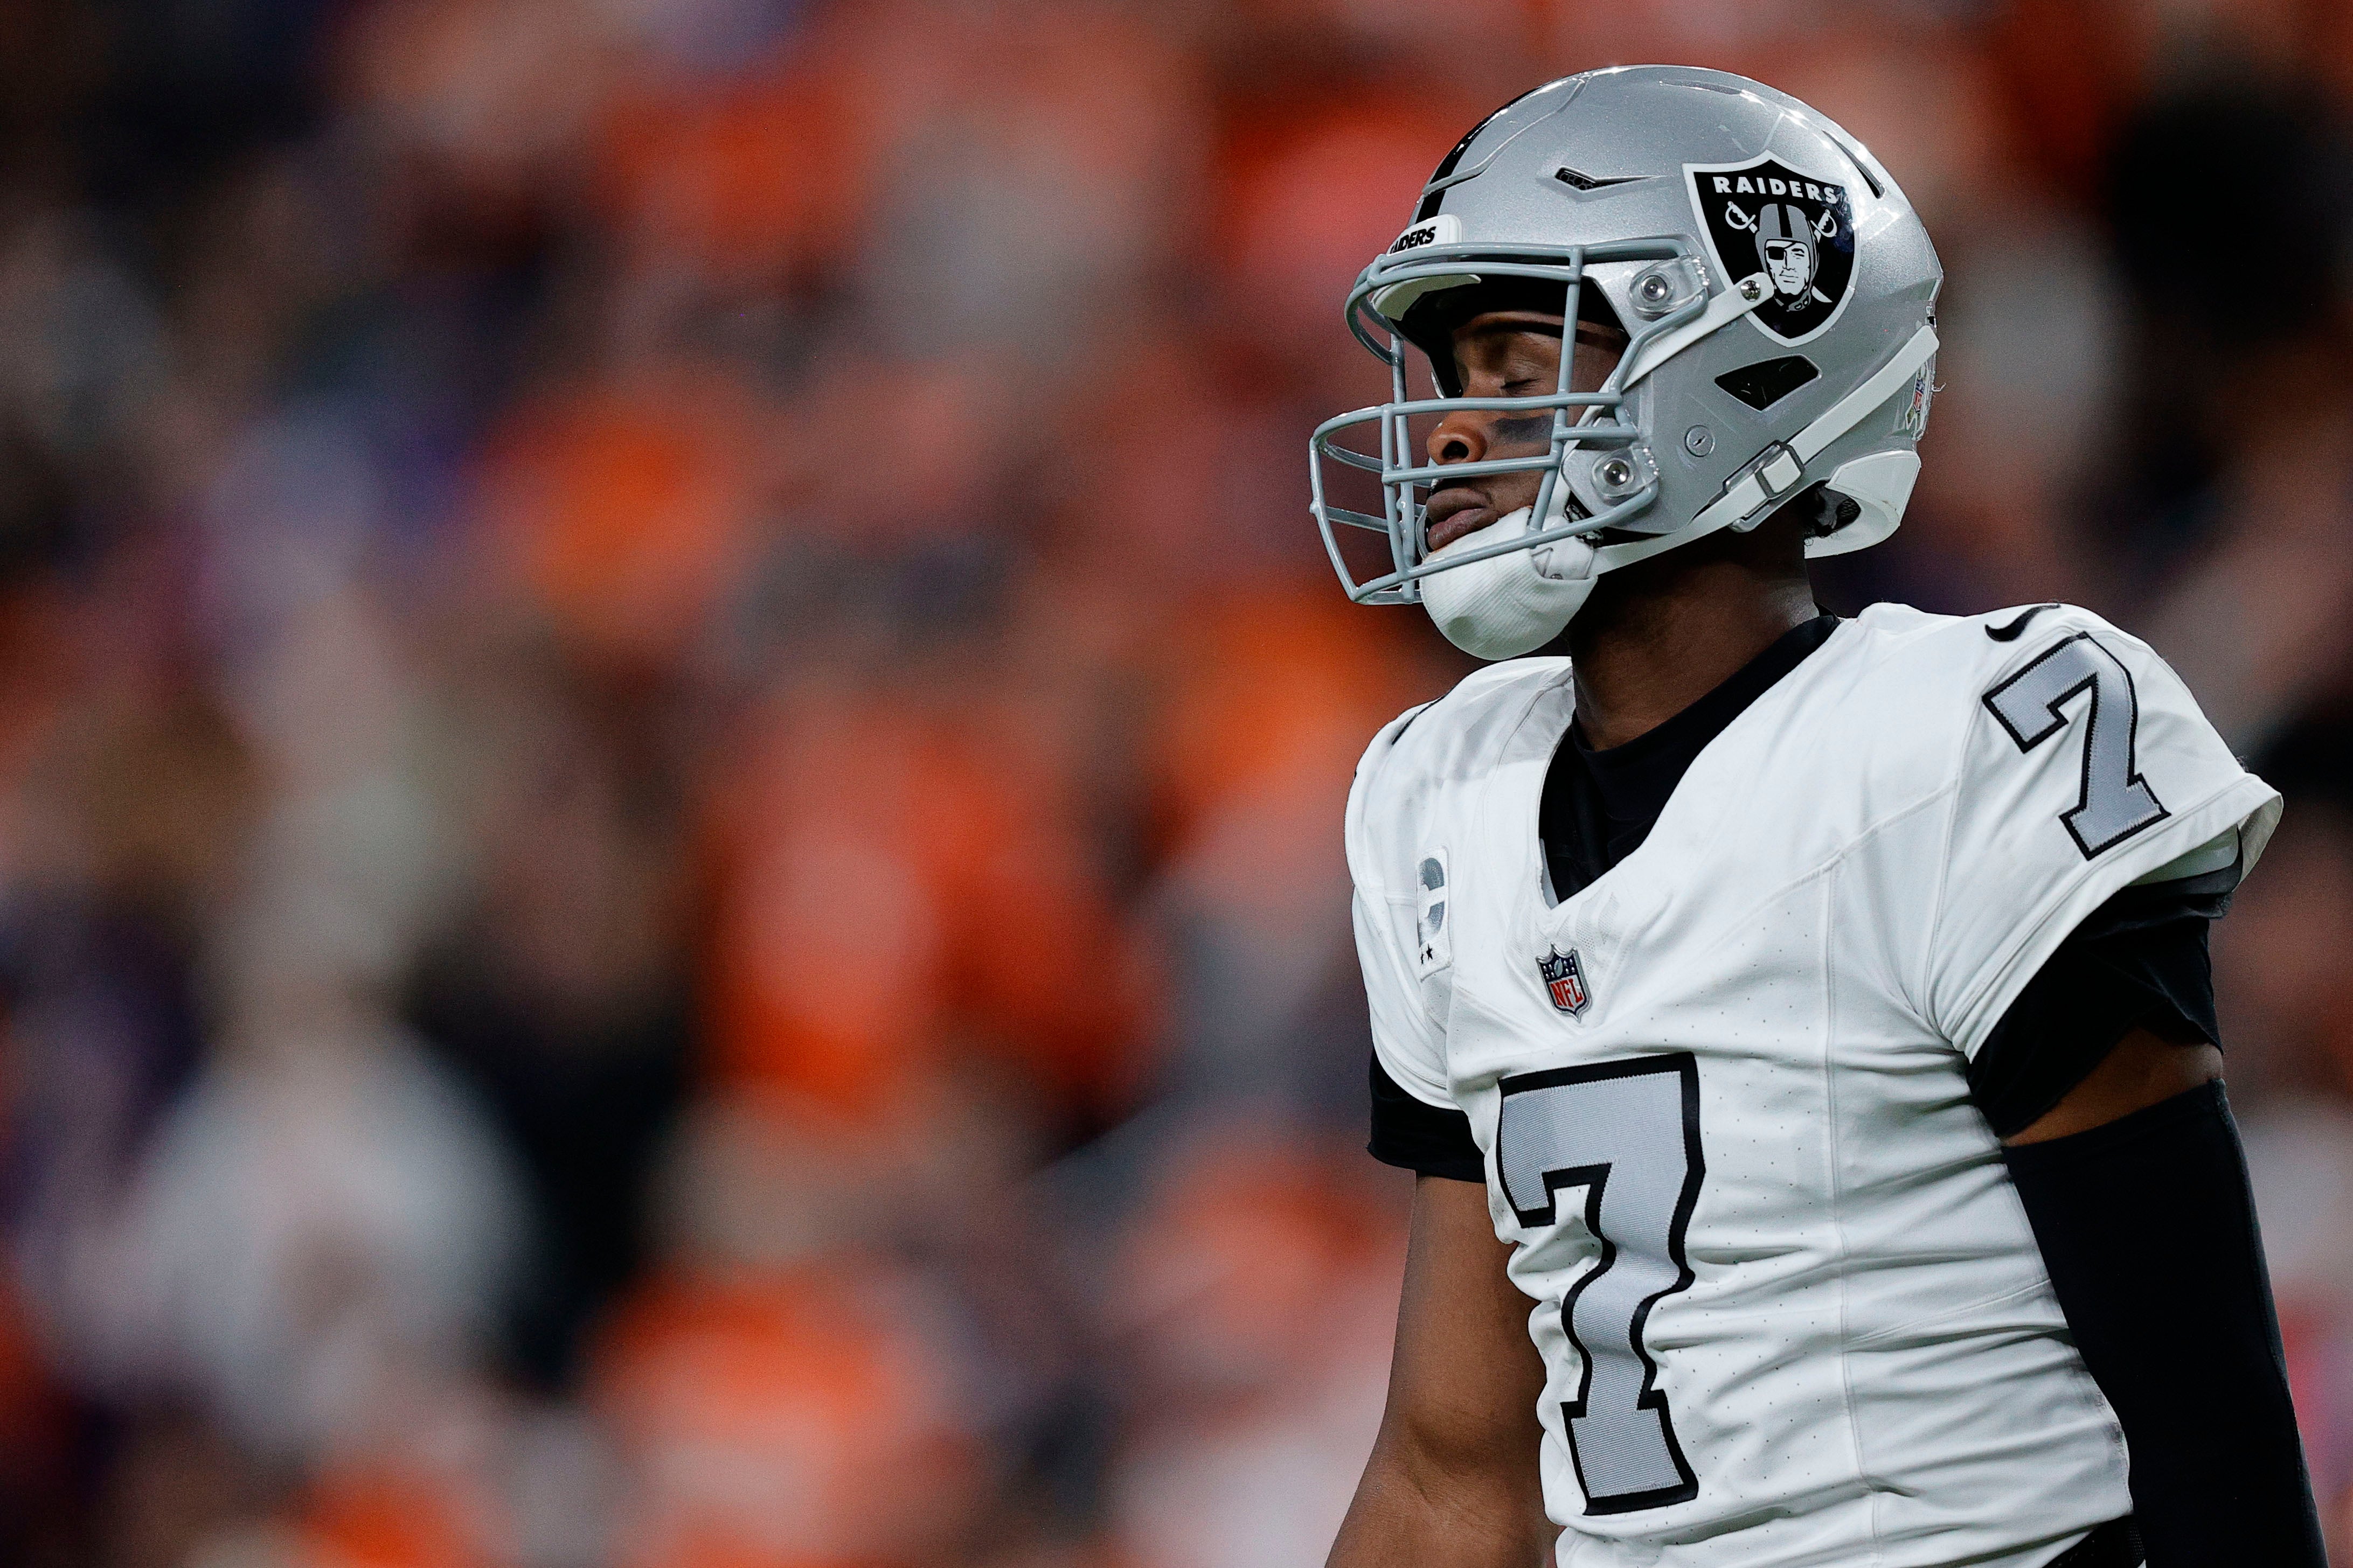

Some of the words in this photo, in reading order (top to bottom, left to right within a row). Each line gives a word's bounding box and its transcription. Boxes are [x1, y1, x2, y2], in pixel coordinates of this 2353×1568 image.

[1712, 176, 1837, 204] RAIDERS
[1982, 631, 2171, 861] 7
[1550, 978, 1584, 1008] NFL
[1496, 1051, 1706, 1515] 7
